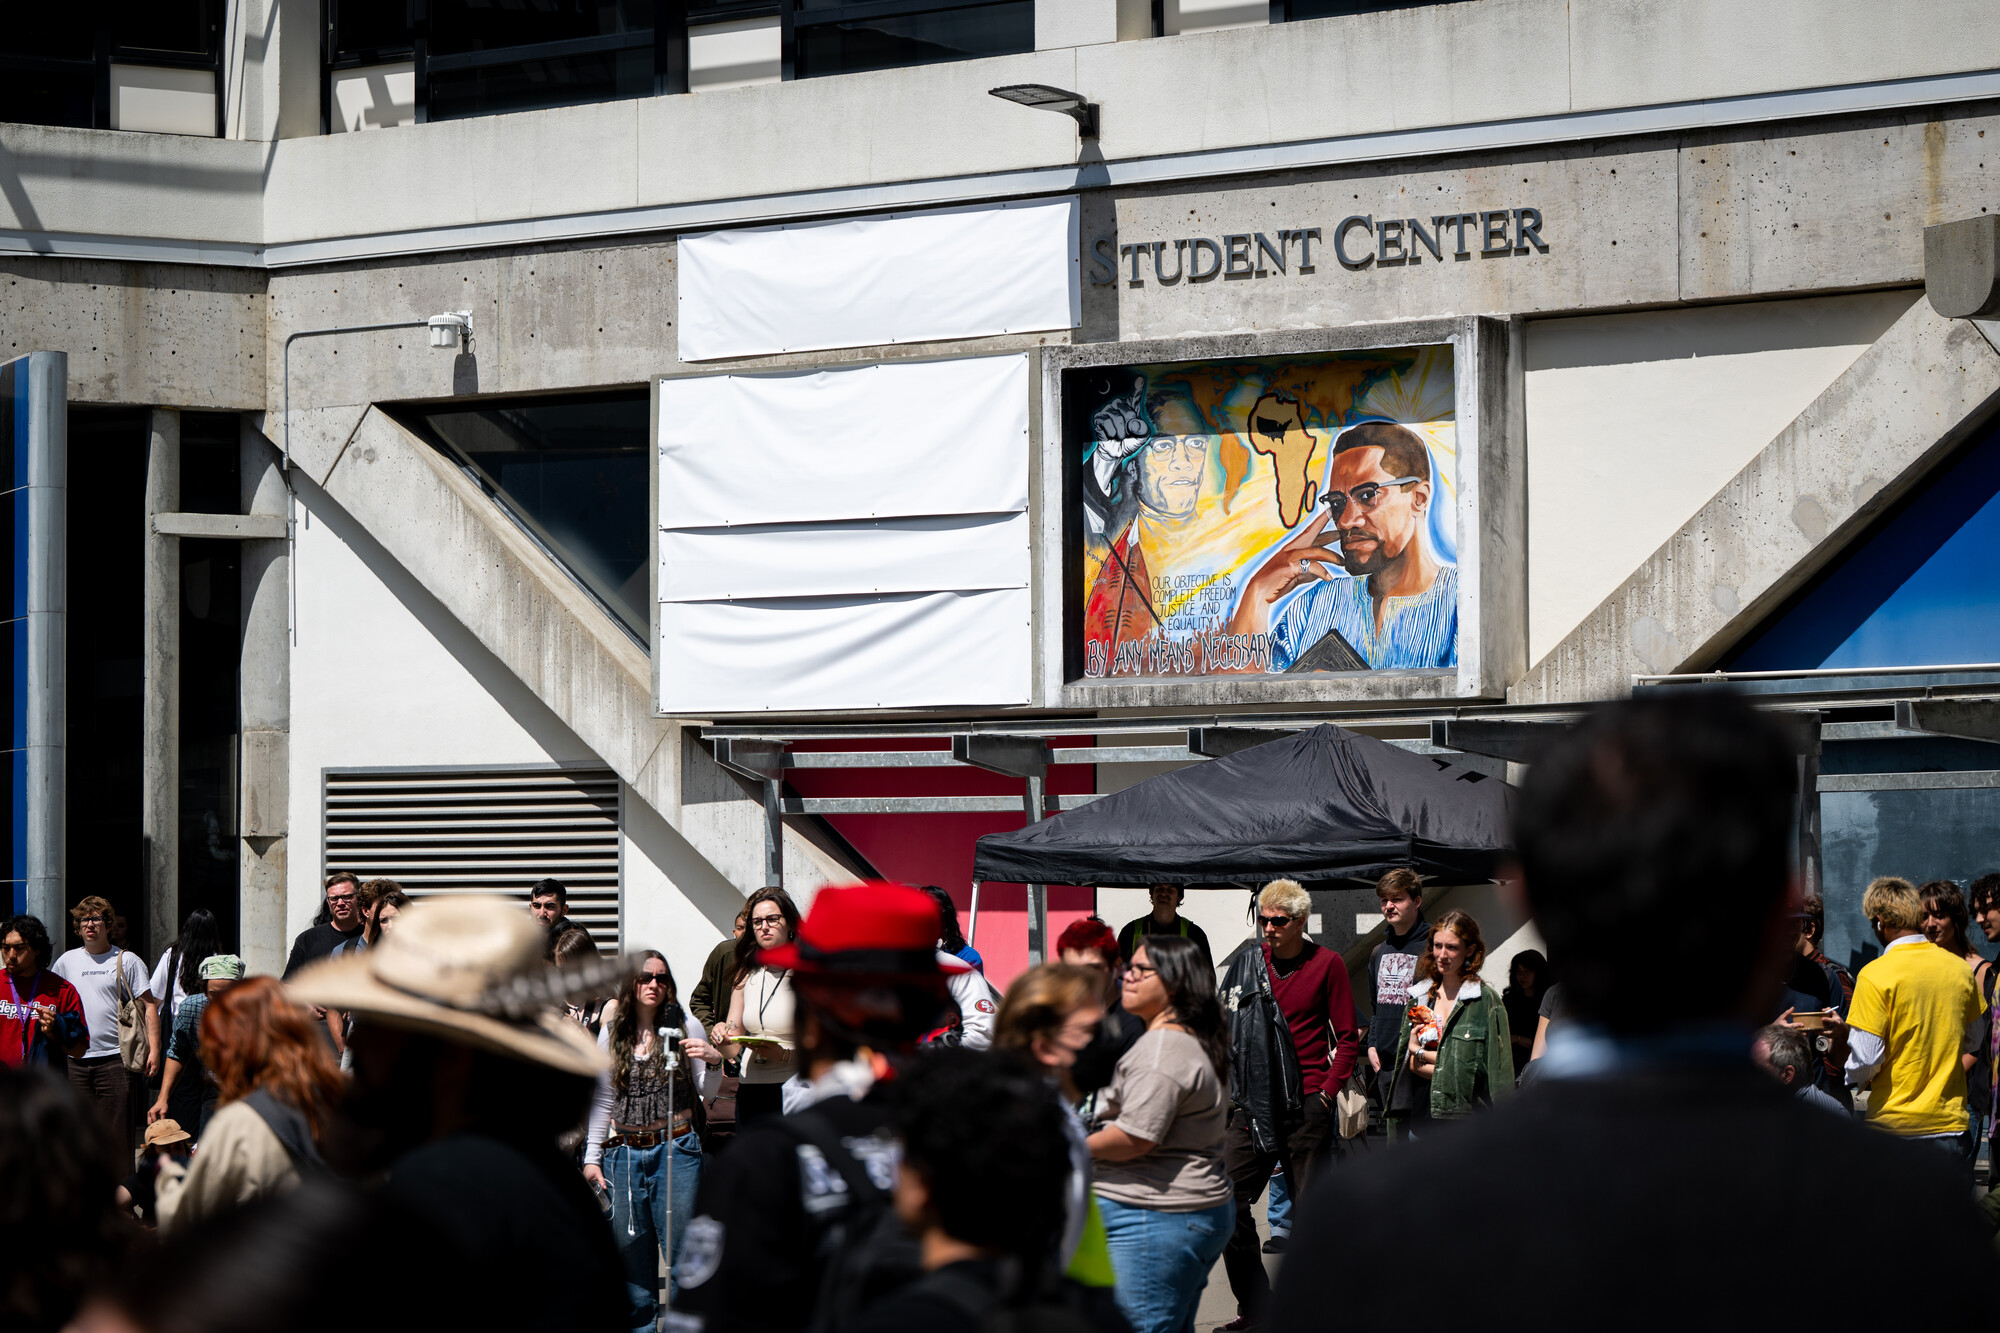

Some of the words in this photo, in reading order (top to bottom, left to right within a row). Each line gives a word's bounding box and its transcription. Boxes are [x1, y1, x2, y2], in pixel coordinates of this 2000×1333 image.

[1090, 227, 1321, 287] STUDENT
[1334, 207, 1549, 268] CENTER
[1152, 576, 1171, 589] OUR
[1174, 574, 1217, 588] OBJECTIVE
[1222, 573, 1231, 586] IS
[1153, 588, 1195, 603] COMPLETE
[1199, 586, 1237, 602] FREEDOM
[1158, 602, 1195, 618] JUSTICE
[1200, 602, 1220, 615] AND
[1168, 616, 1213, 631] EQUALITY
[1085, 639, 1109, 678] BY
[1113, 639, 1144, 676] ANY
[1149, 635, 1194, 674] MEANS
[1200, 631, 1277, 673] NECESSARY
[1379, 984, 1405, 995] adidas
